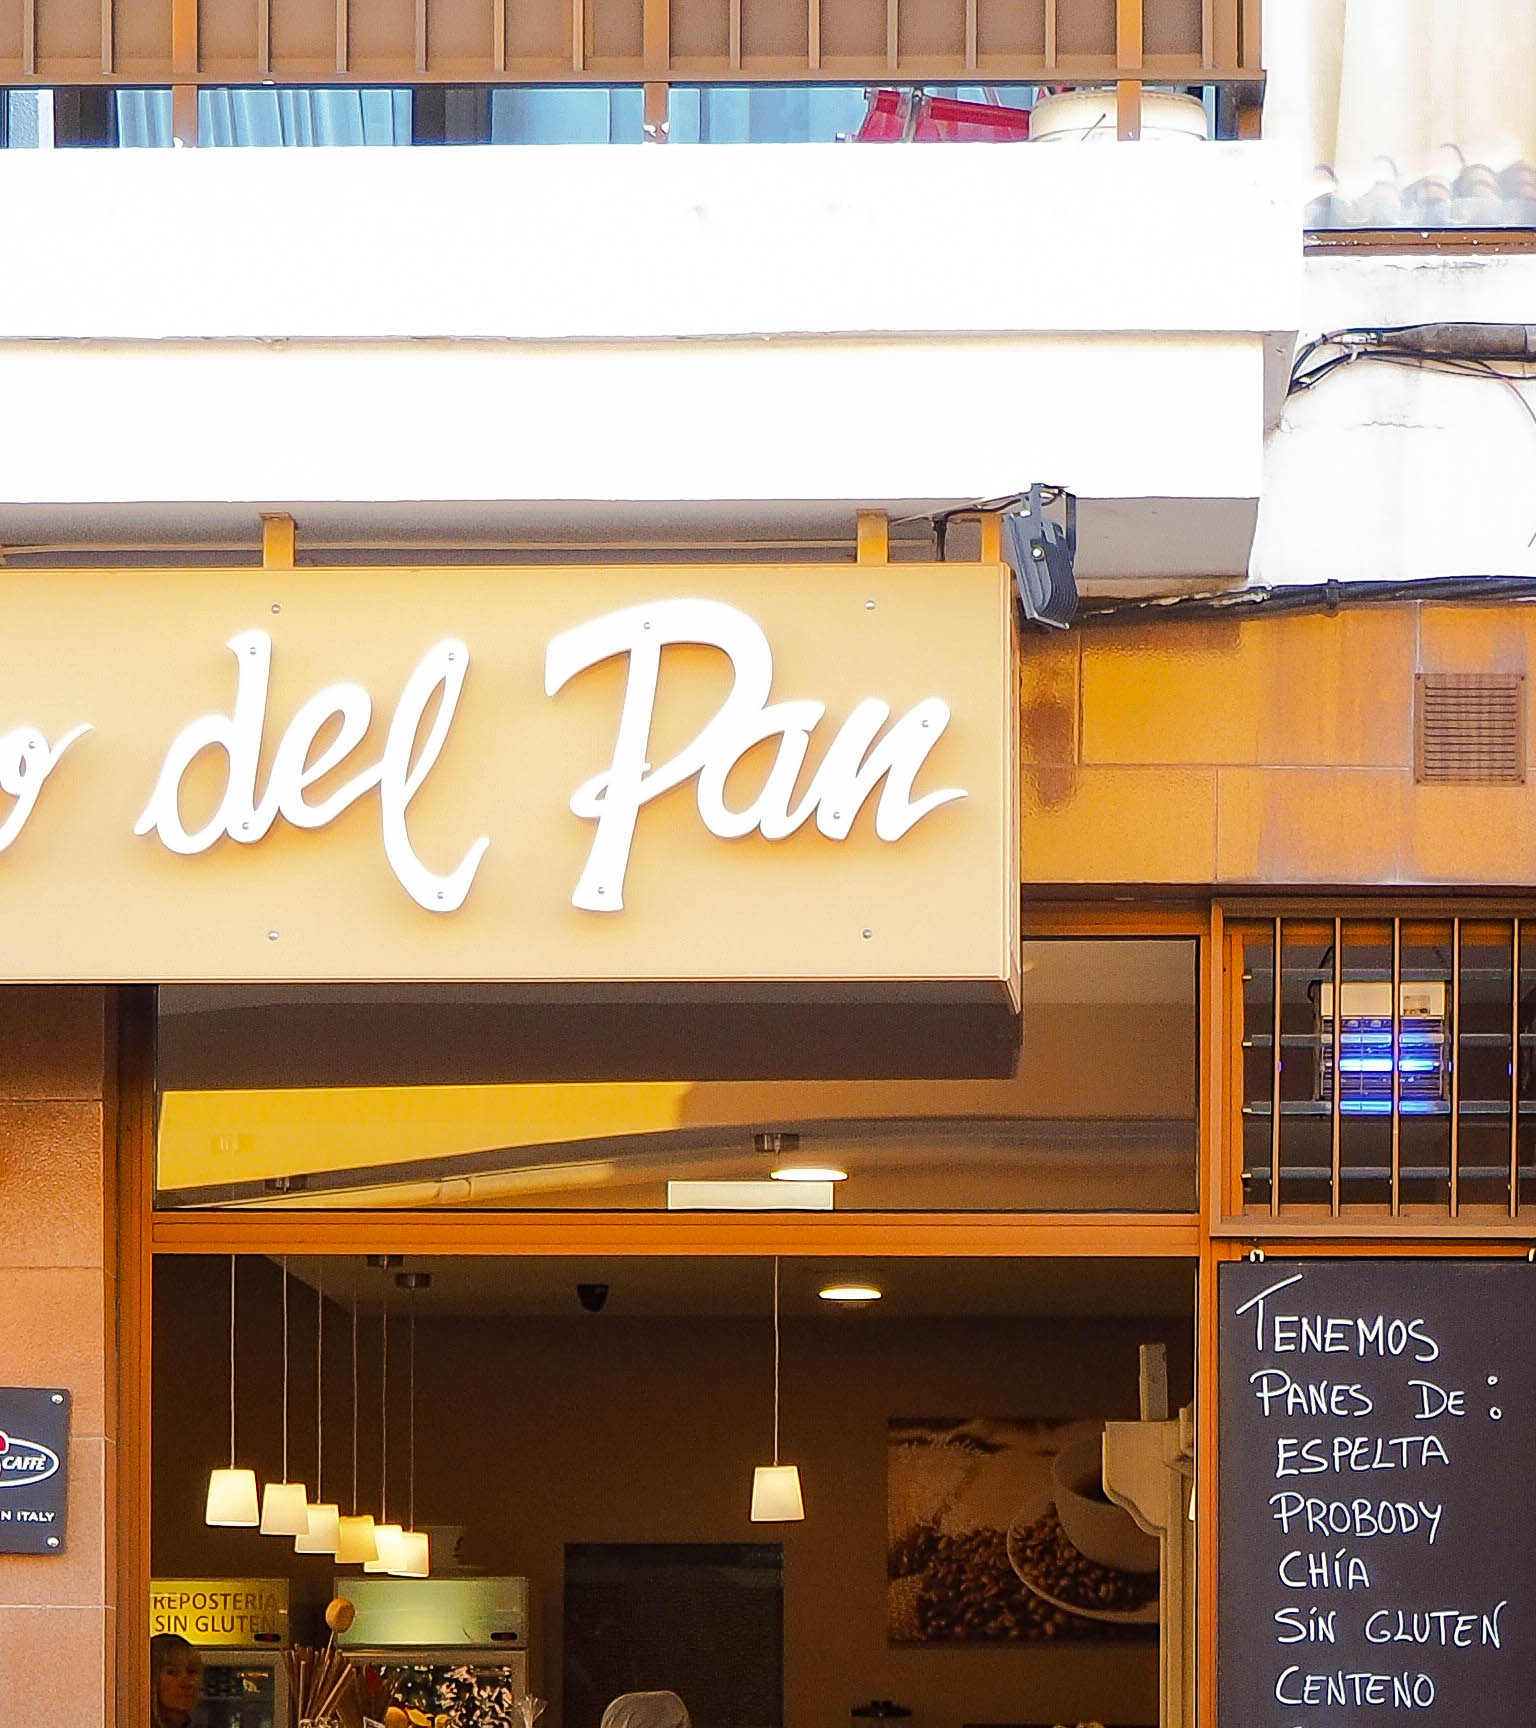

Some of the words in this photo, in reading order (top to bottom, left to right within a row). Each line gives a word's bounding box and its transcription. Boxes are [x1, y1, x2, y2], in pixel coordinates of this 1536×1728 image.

[132, 629, 490, 917] del
[542, 597, 970, 912] Pan
[1236, 1273, 1440, 1363] TENEMOS
[1249, 1367, 1373, 1417] PANES
[1407, 1379, 1465, 1420] DE
[1274, 1434, 1450, 1480] ESPELTA
[16, 1509, 56, 1523] ITALY
[1268, 1490, 1444, 1545] PROBODY
[1277, 1547, 1371, 1590] CHÍA
[155, 1615, 187, 1632] SIN
[195, 1615, 276, 1633] GLUTEN
[1364, 1600, 1508, 1649] GLUTEN
[1274, 1664, 1436, 1709] CENTENO
